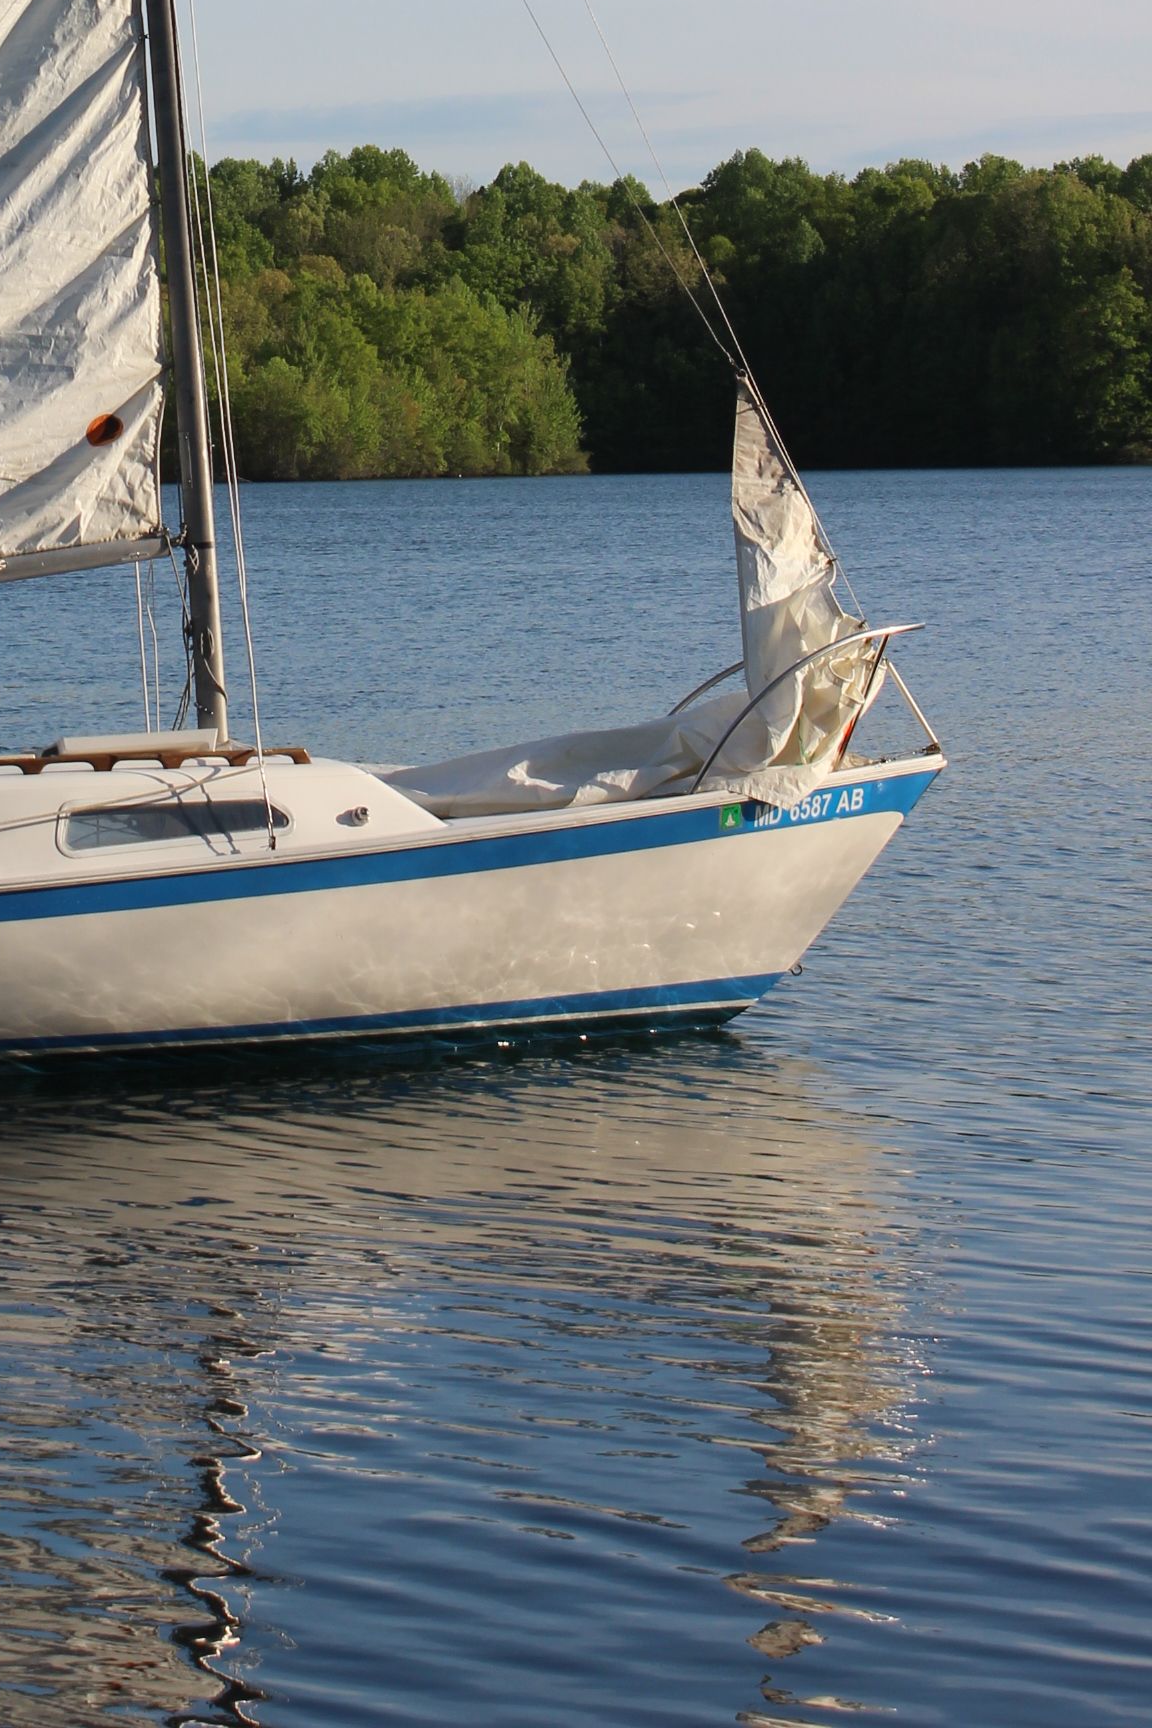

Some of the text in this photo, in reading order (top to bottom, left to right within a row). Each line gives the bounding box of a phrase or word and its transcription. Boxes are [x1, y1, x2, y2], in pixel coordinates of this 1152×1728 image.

[754, 788, 864, 827] MD 6587 AB
